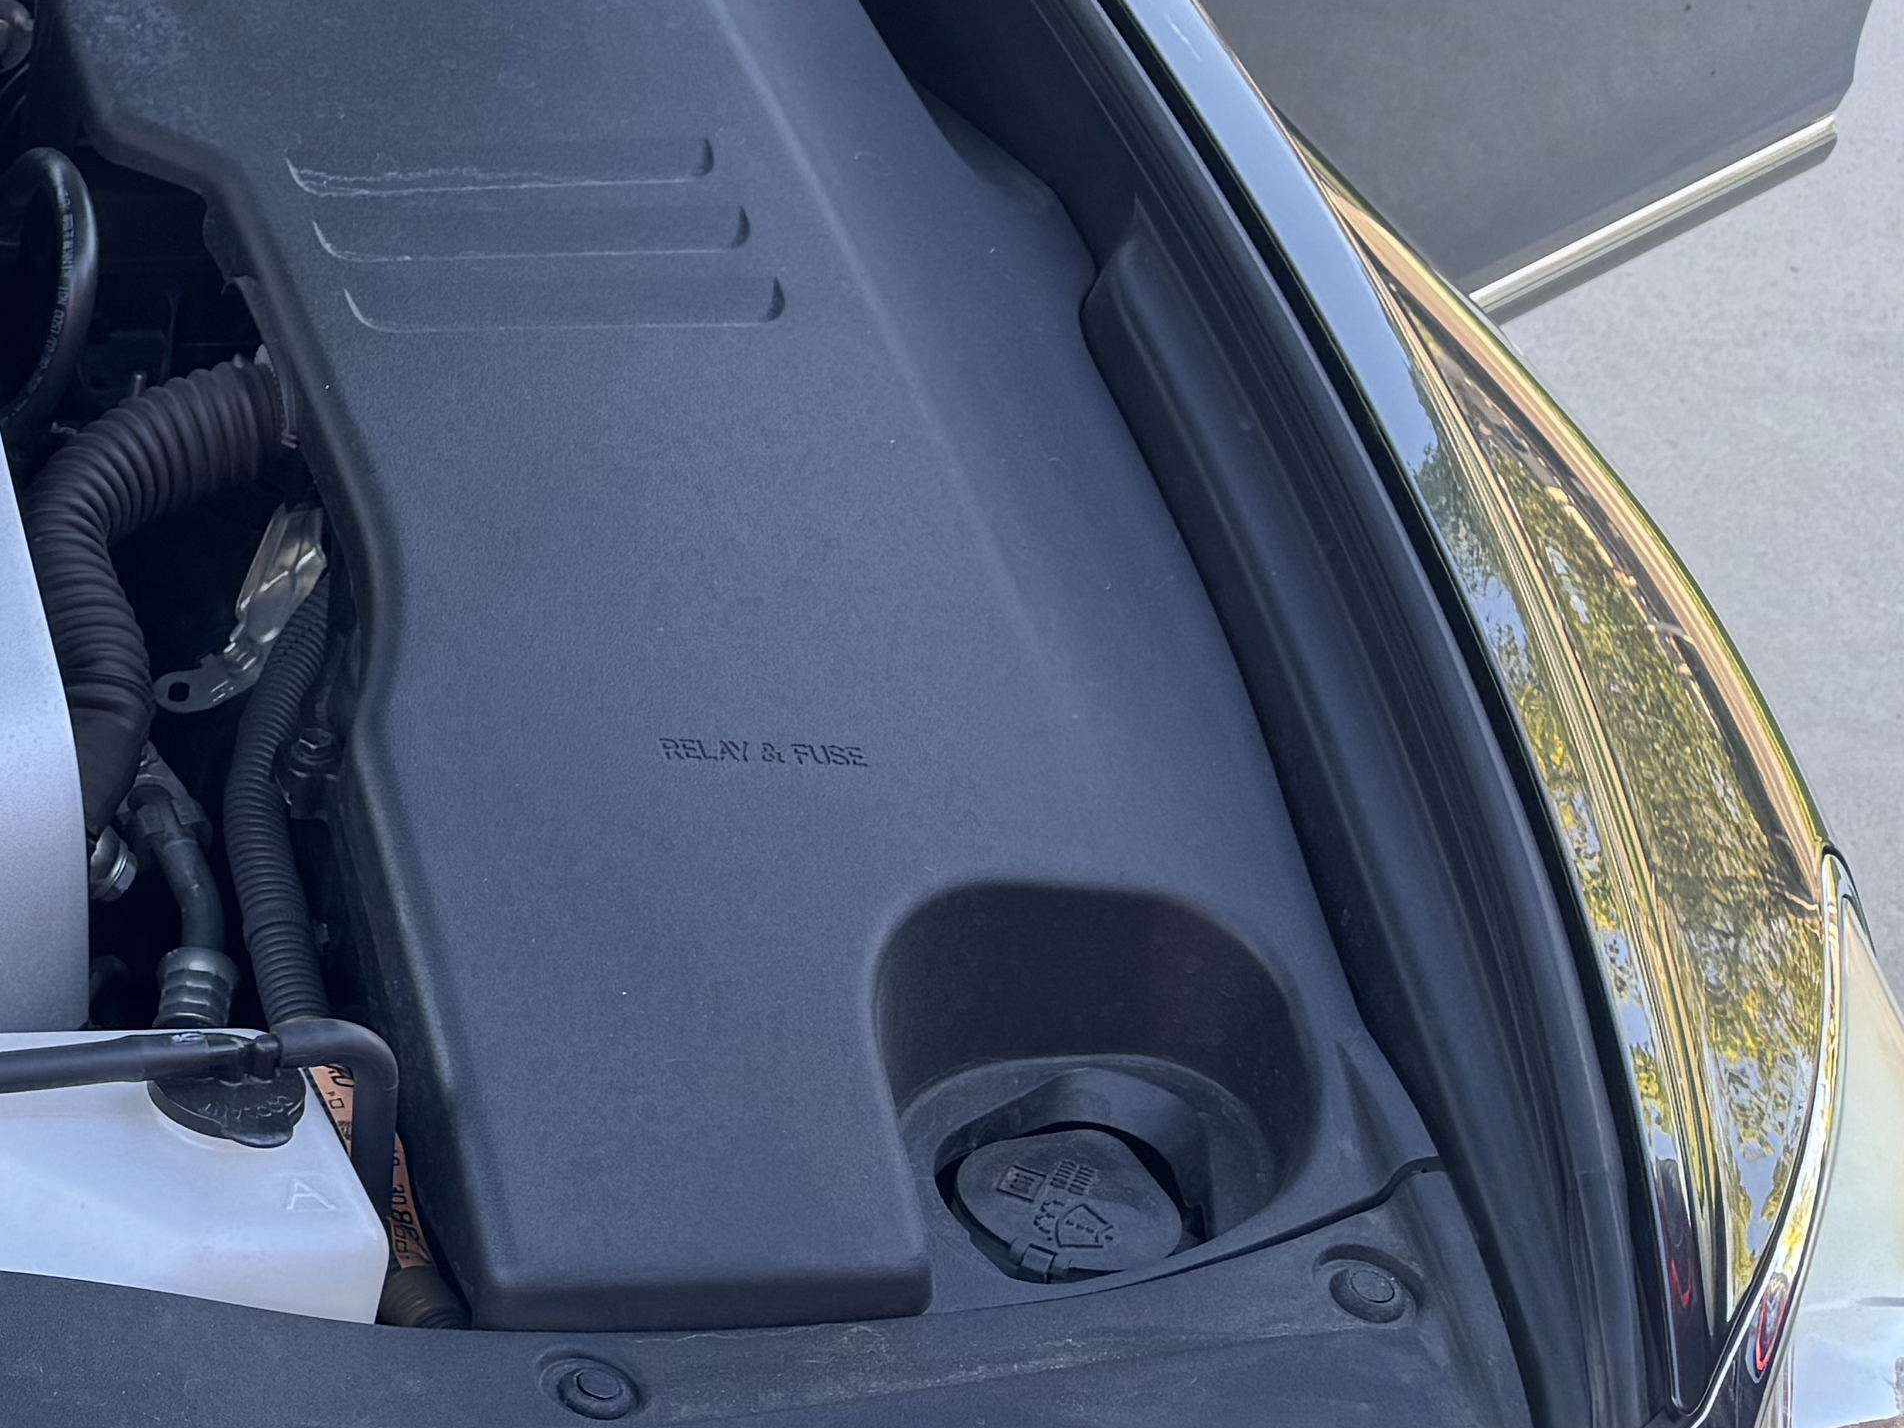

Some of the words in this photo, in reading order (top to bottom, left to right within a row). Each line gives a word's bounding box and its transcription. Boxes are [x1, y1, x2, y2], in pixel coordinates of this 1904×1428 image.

[658, 737, 749, 763] RELAY
[760, 741, 786, 764] &
[790, 743, 868, 768] FUSE
